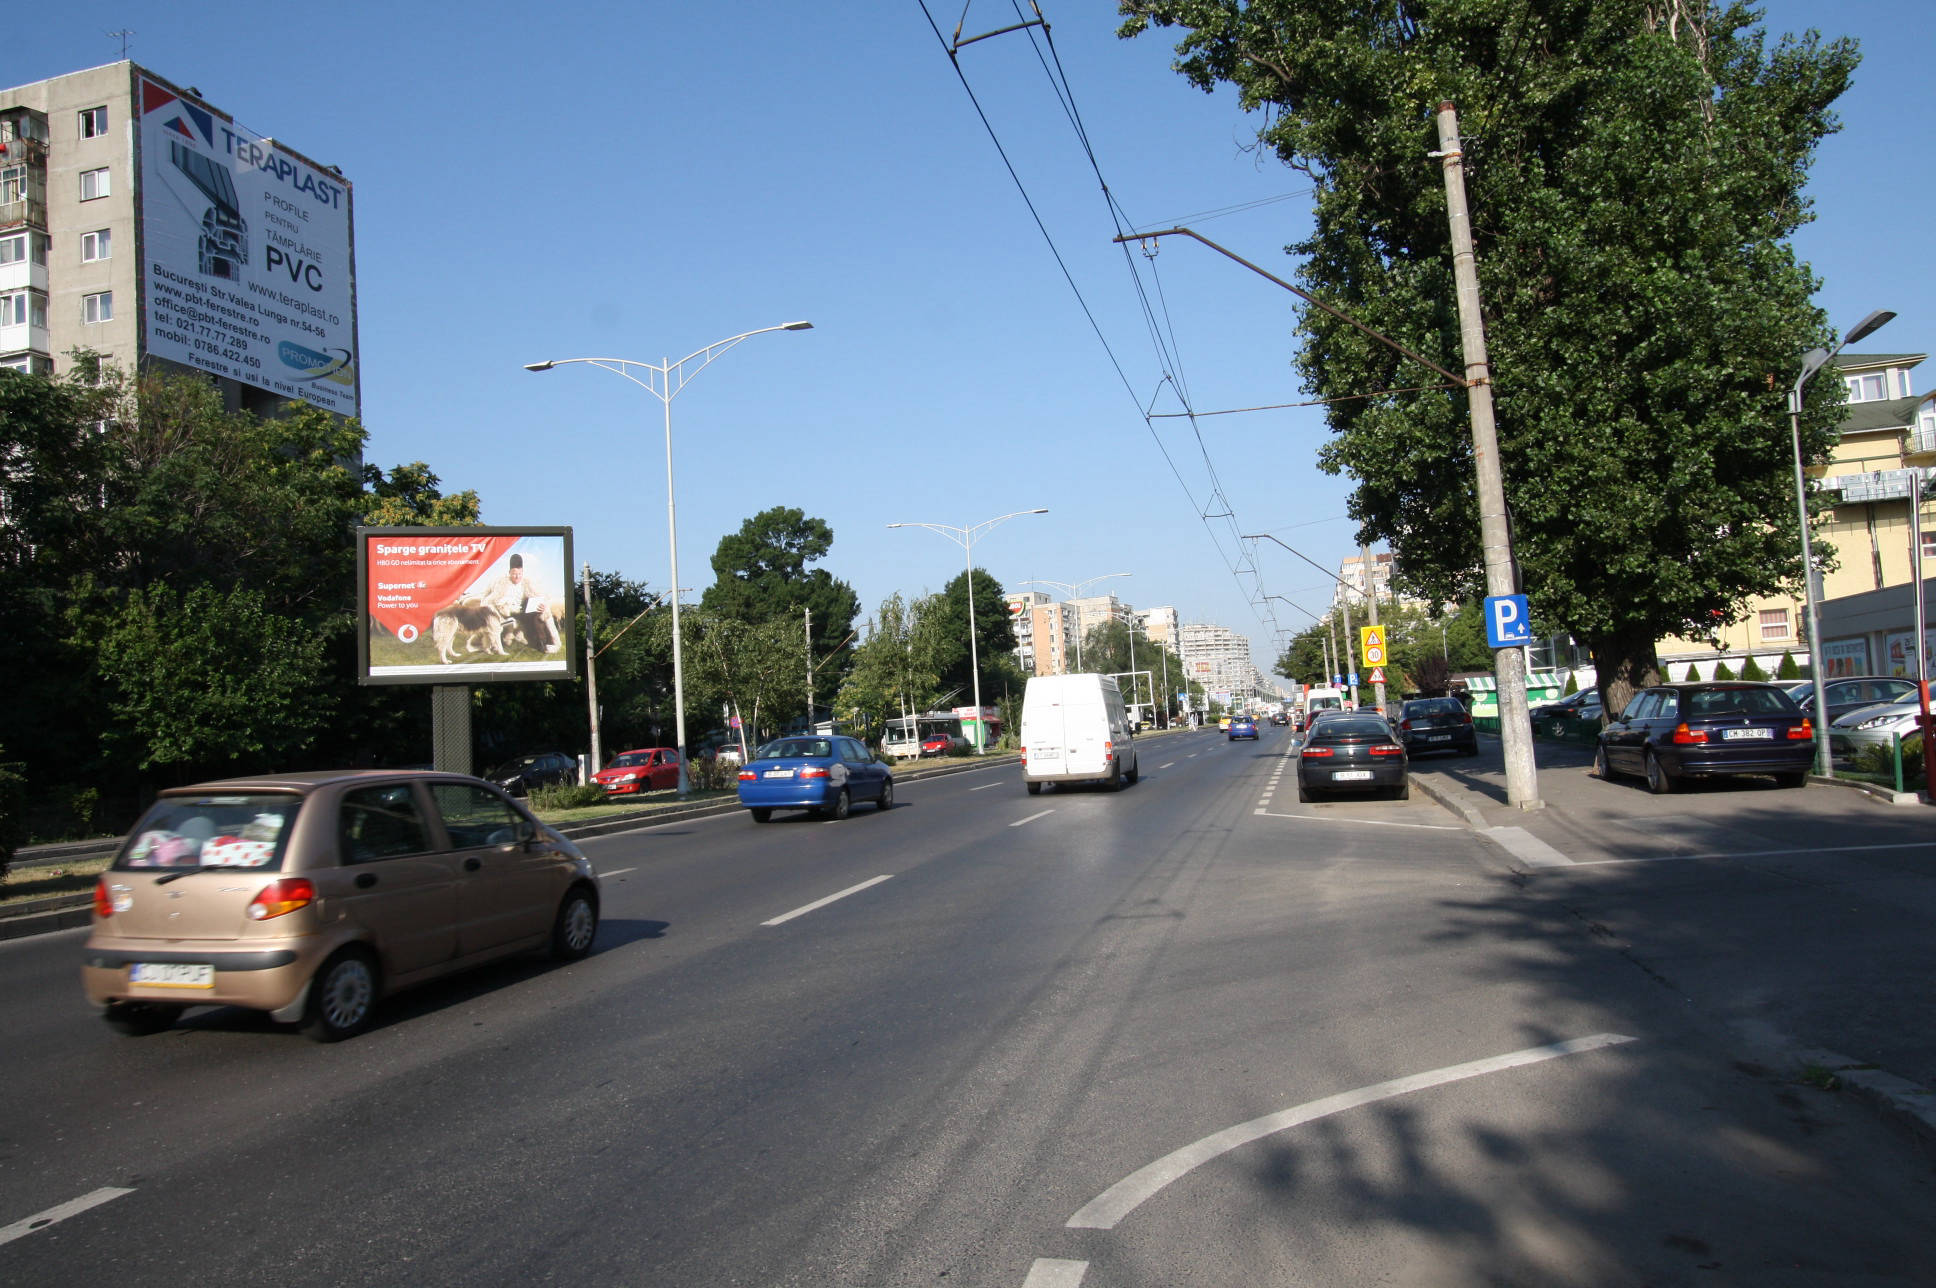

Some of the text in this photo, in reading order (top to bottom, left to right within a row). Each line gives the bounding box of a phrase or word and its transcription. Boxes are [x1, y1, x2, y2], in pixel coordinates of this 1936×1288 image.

[221, 127, 342, 210] TERAPLAST
[264, 191, 310, 223] PROFILE
[265, 211, 299, 234] PENTRU
[266, 244, 323, 292] PVC
[153, 280, 260, 327] www.pbt-ferestre.ro
[154, 297, 271, 345] office@pbt-ferestre.ro
[248, 281, 340, 326] www.teraplast.ro
[257, 305, 288, 324] Lunga
[154, 311, 248, 351] tel: 021.77.77.289
[155, 327, 261, 369] mobil: 0786.422.450
[188, 352, 229, 373] Ferestre
[262, 375, 270, 387] la
[274, 380, 294, 394] nivel
[298, 387, 337, 408] European
[376, 543, 487, 556] Sparge granițele TV
[377, 582, 416, 591] Supernet
[1494, 599, 1518, 641] P
